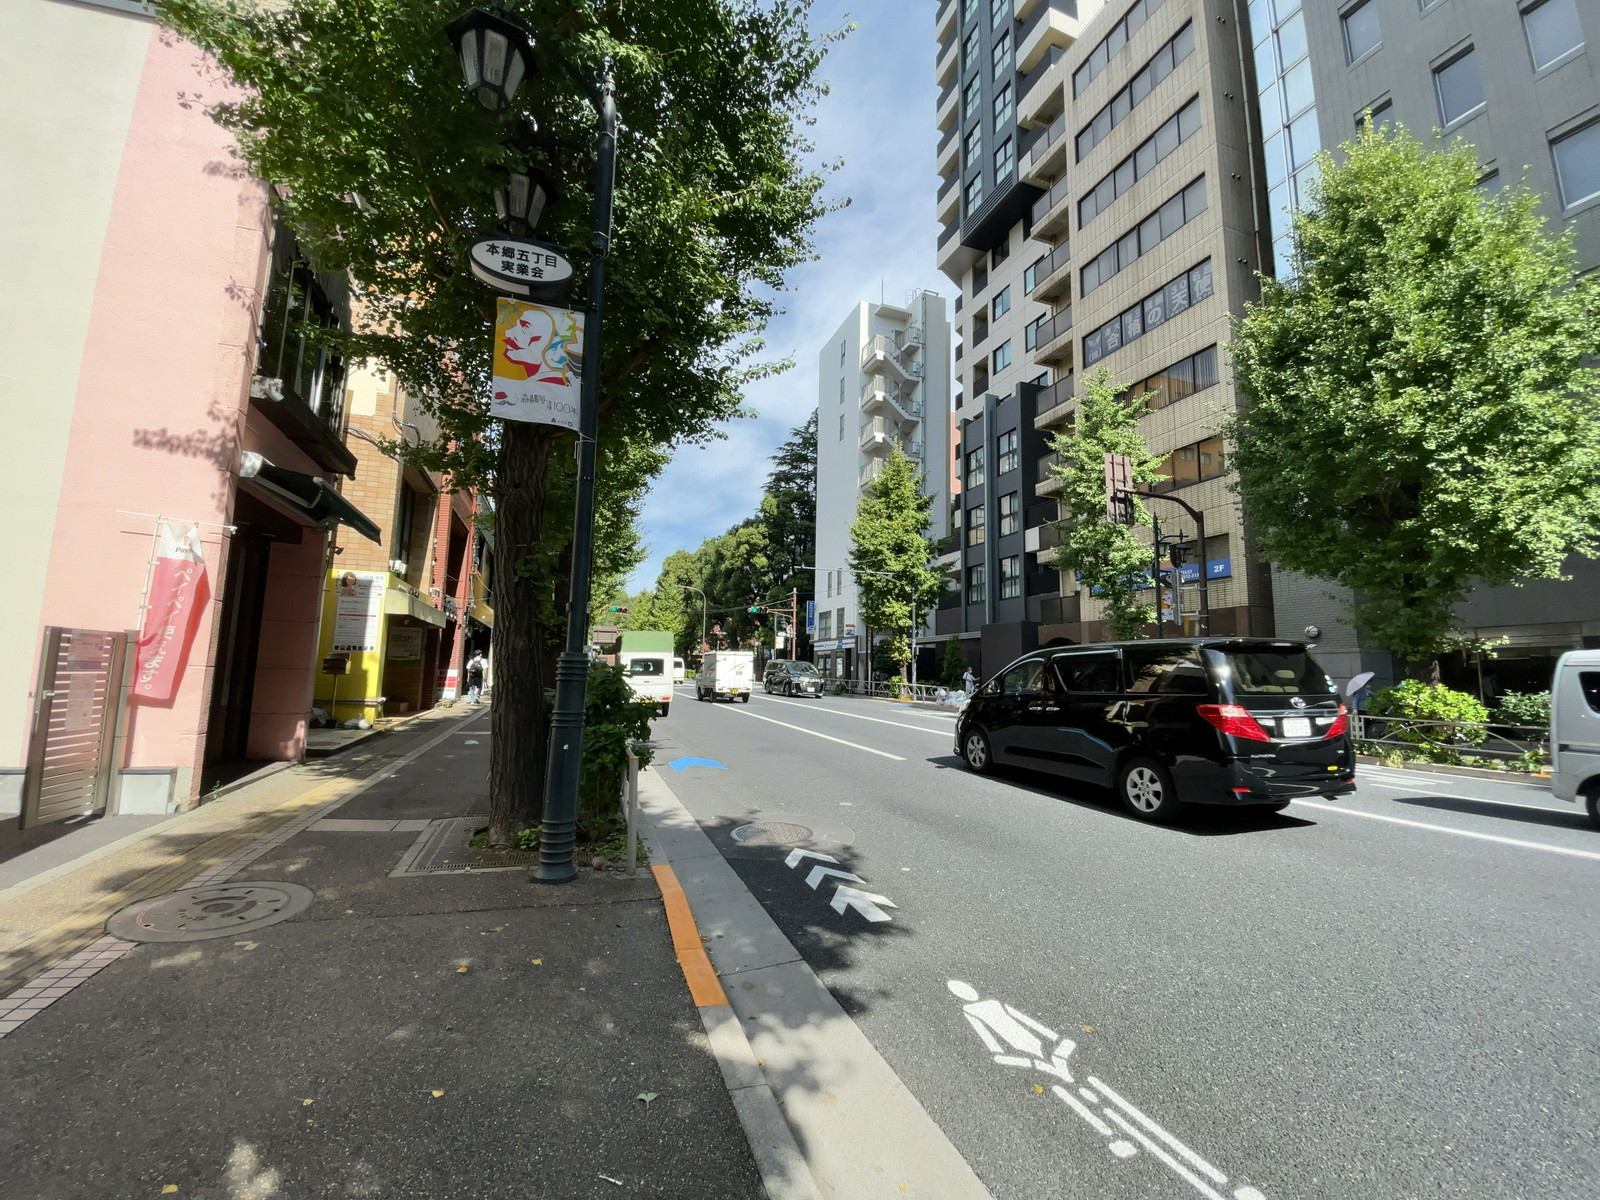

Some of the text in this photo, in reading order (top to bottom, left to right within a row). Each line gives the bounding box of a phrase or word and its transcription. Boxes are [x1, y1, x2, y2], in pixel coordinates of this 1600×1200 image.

[486, 242, 557, 268] 本郷五丁目
[501, 260, 544, 279] 実業会
[1213, 564, 1224, 572] 2F
